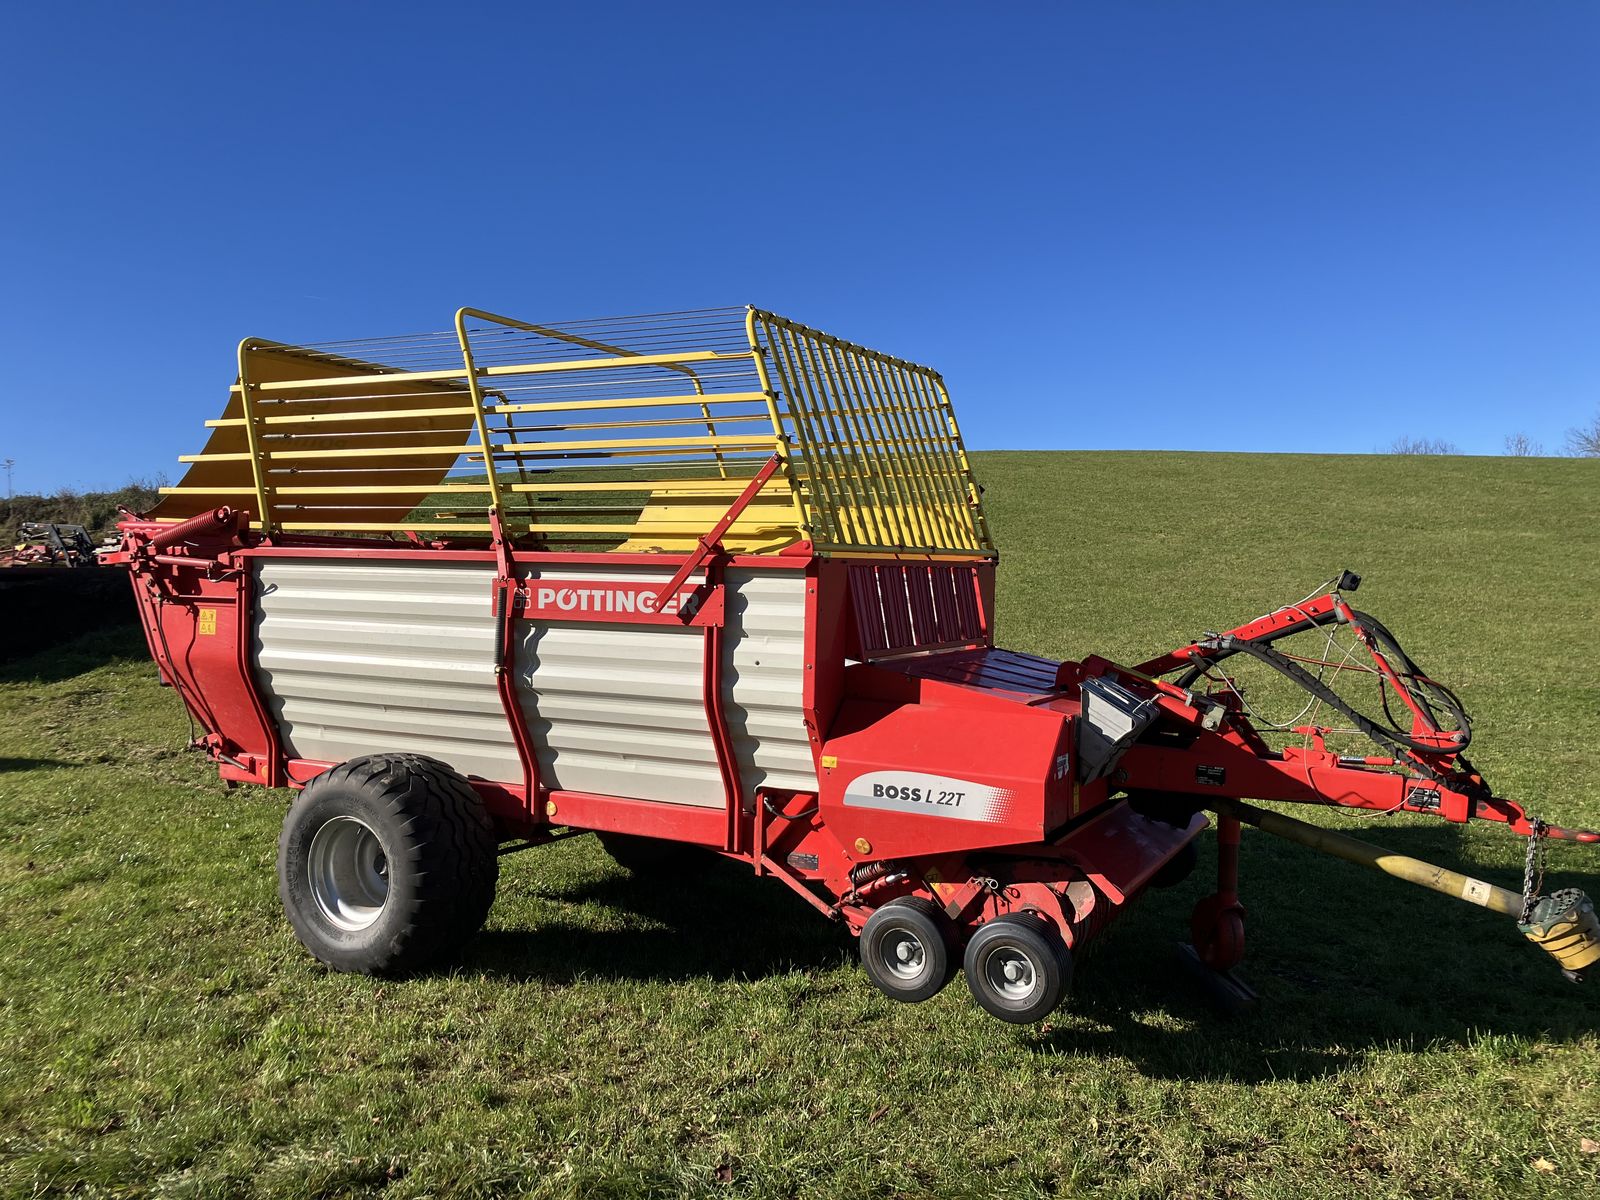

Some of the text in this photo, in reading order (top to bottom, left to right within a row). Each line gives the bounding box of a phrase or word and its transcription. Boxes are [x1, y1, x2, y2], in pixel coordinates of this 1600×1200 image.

[873, 783, 965, 807] BOSS L 22T
